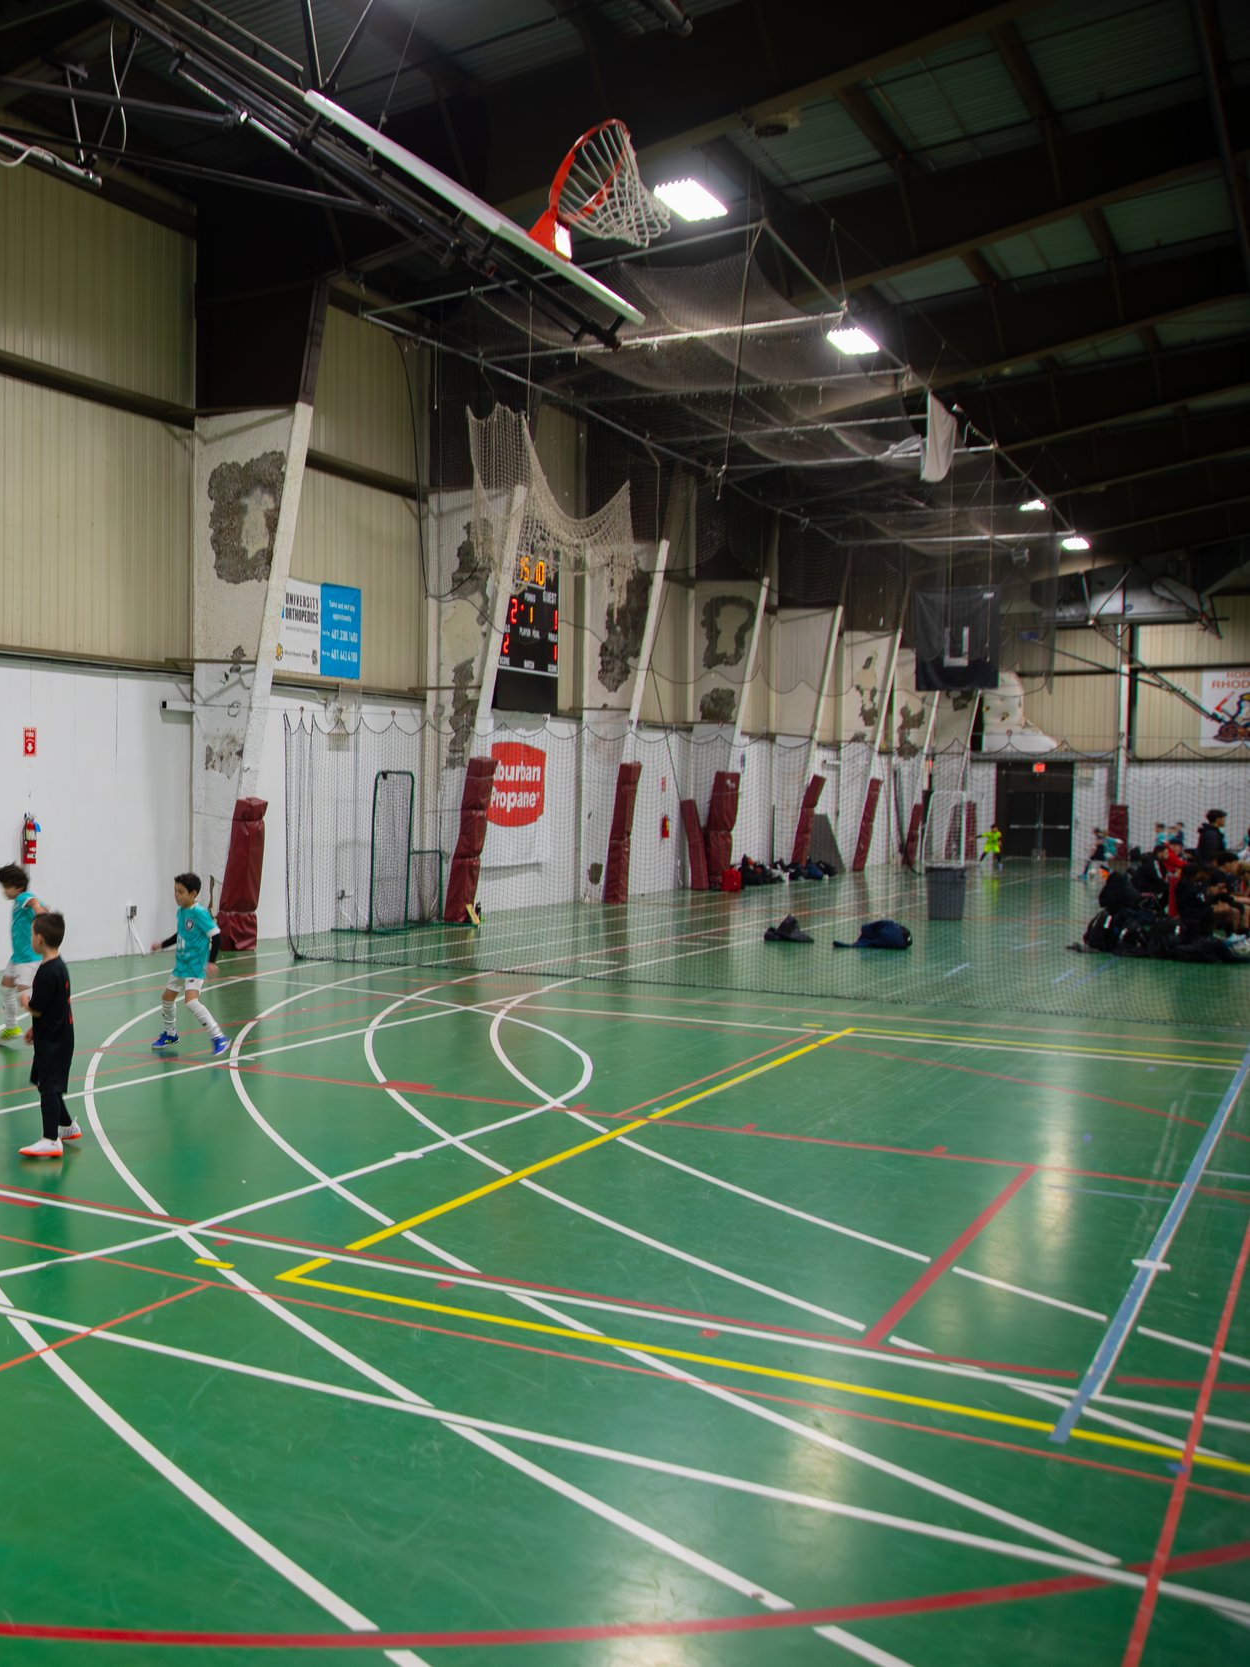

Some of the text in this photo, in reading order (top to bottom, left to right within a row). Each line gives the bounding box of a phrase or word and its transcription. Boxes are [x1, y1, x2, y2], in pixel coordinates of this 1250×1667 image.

[285, 592, 319, 610] UNIVERSITY
[543, 591, 557, 604] GUEST
[285, 608, 319, 624] ORTHOPEDICS
[1211, 680, 1250, 689] RHOD
[493, 759, 541, 782] burban
[490, 785, 537, 813] Propane
